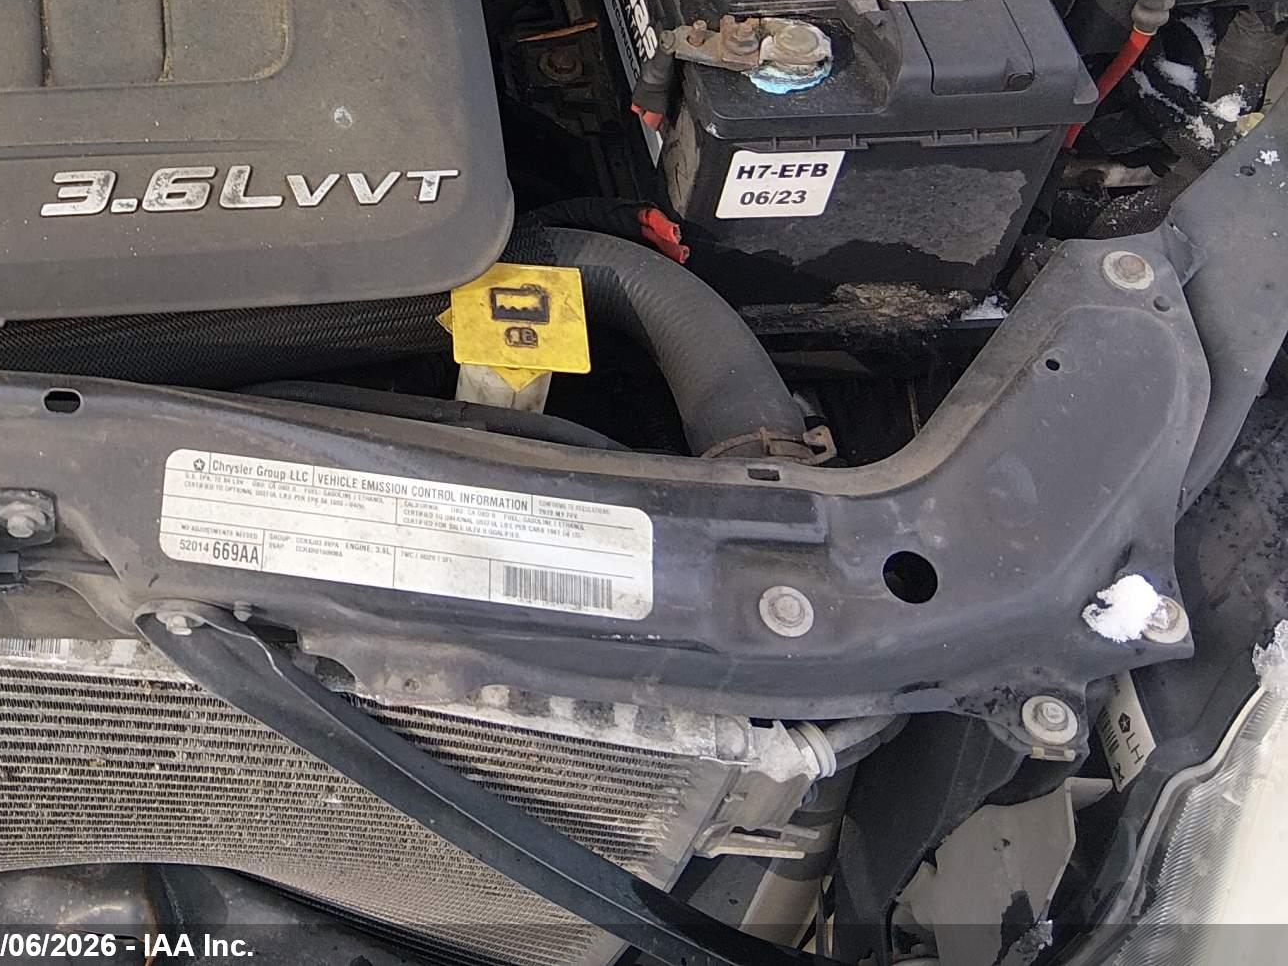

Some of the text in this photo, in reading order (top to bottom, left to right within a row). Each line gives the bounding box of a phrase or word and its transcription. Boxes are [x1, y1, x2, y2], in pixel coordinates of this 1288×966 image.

[736, 163, 828, 180] H7-EFB
[740, 190, 807, 206] 06/23
[212, 460, 252, 474] Chrysler
[256, 466, 286, 480] Group
[290, 470, 308, 482] LLC
[318, 474, 527, 511] VEHICLE EMISSION CONTROL INFORMATION
[180, 539, 259, 564] 52014 669AA
[1126, 732, 1144, 764] LH
